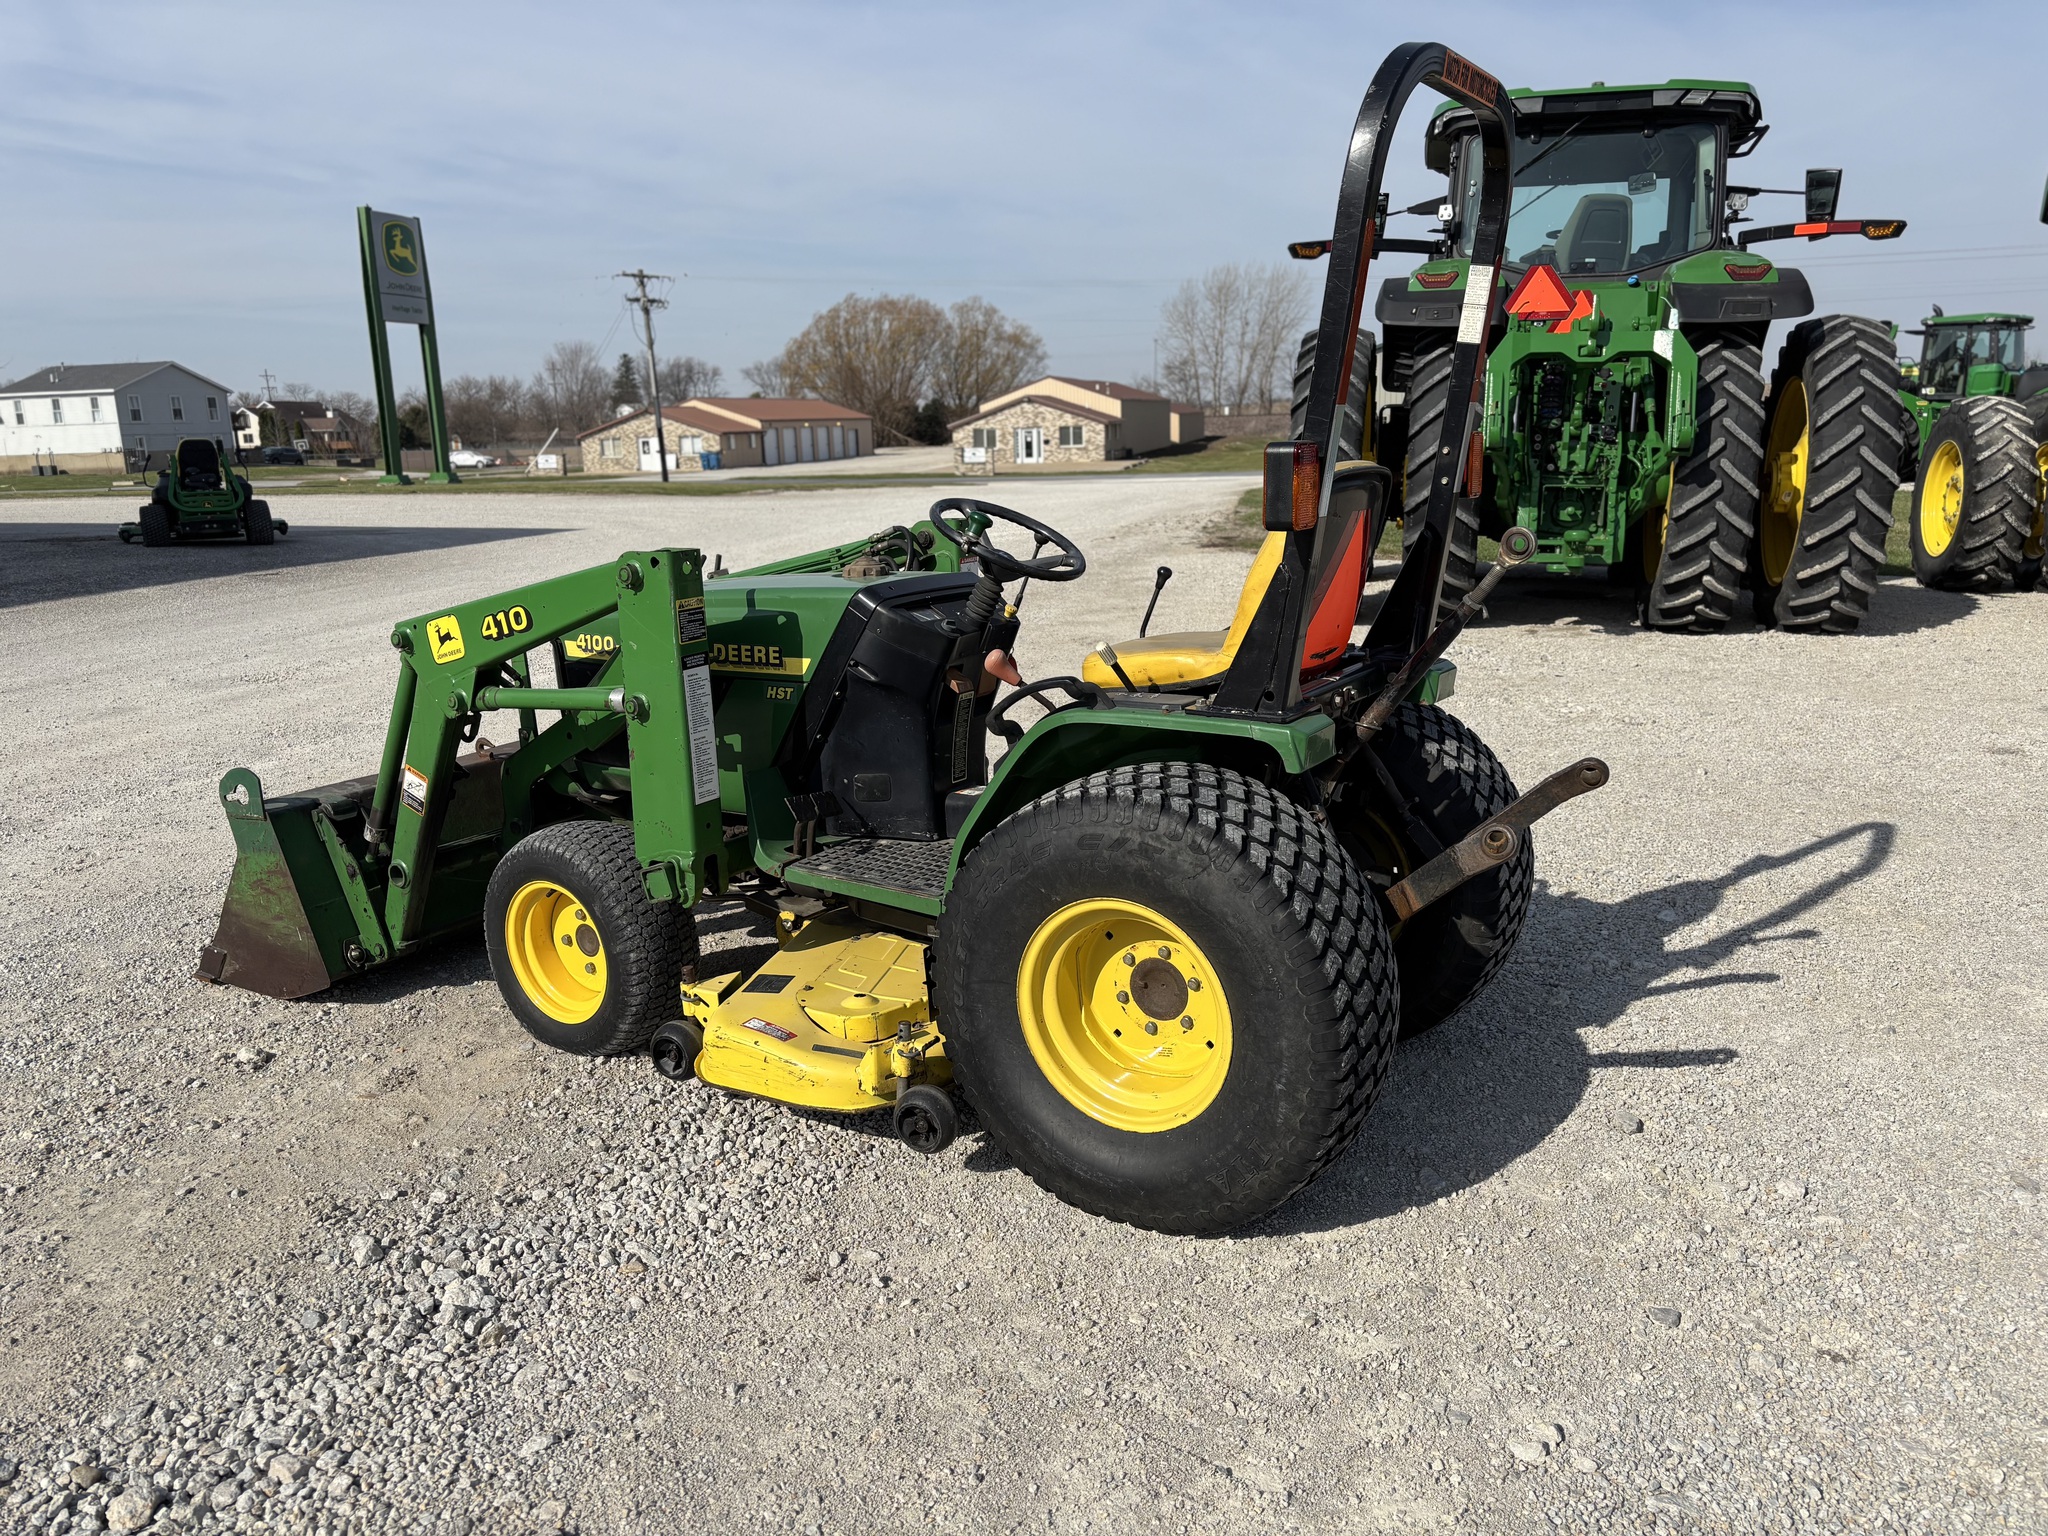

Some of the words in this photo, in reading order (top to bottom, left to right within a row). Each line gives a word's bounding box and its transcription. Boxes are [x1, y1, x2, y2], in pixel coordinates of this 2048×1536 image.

[386, 281, 405, 291] JOHN
[481, 605, 531, 640] 410
[576, 633, 614, 651] 4100
[437, 652, 448, 660] JOHN
[448, 647, 462, 657] DEERE
[713, 643, 781, 665] DEERE
[766, 686, 794, 700] HST
